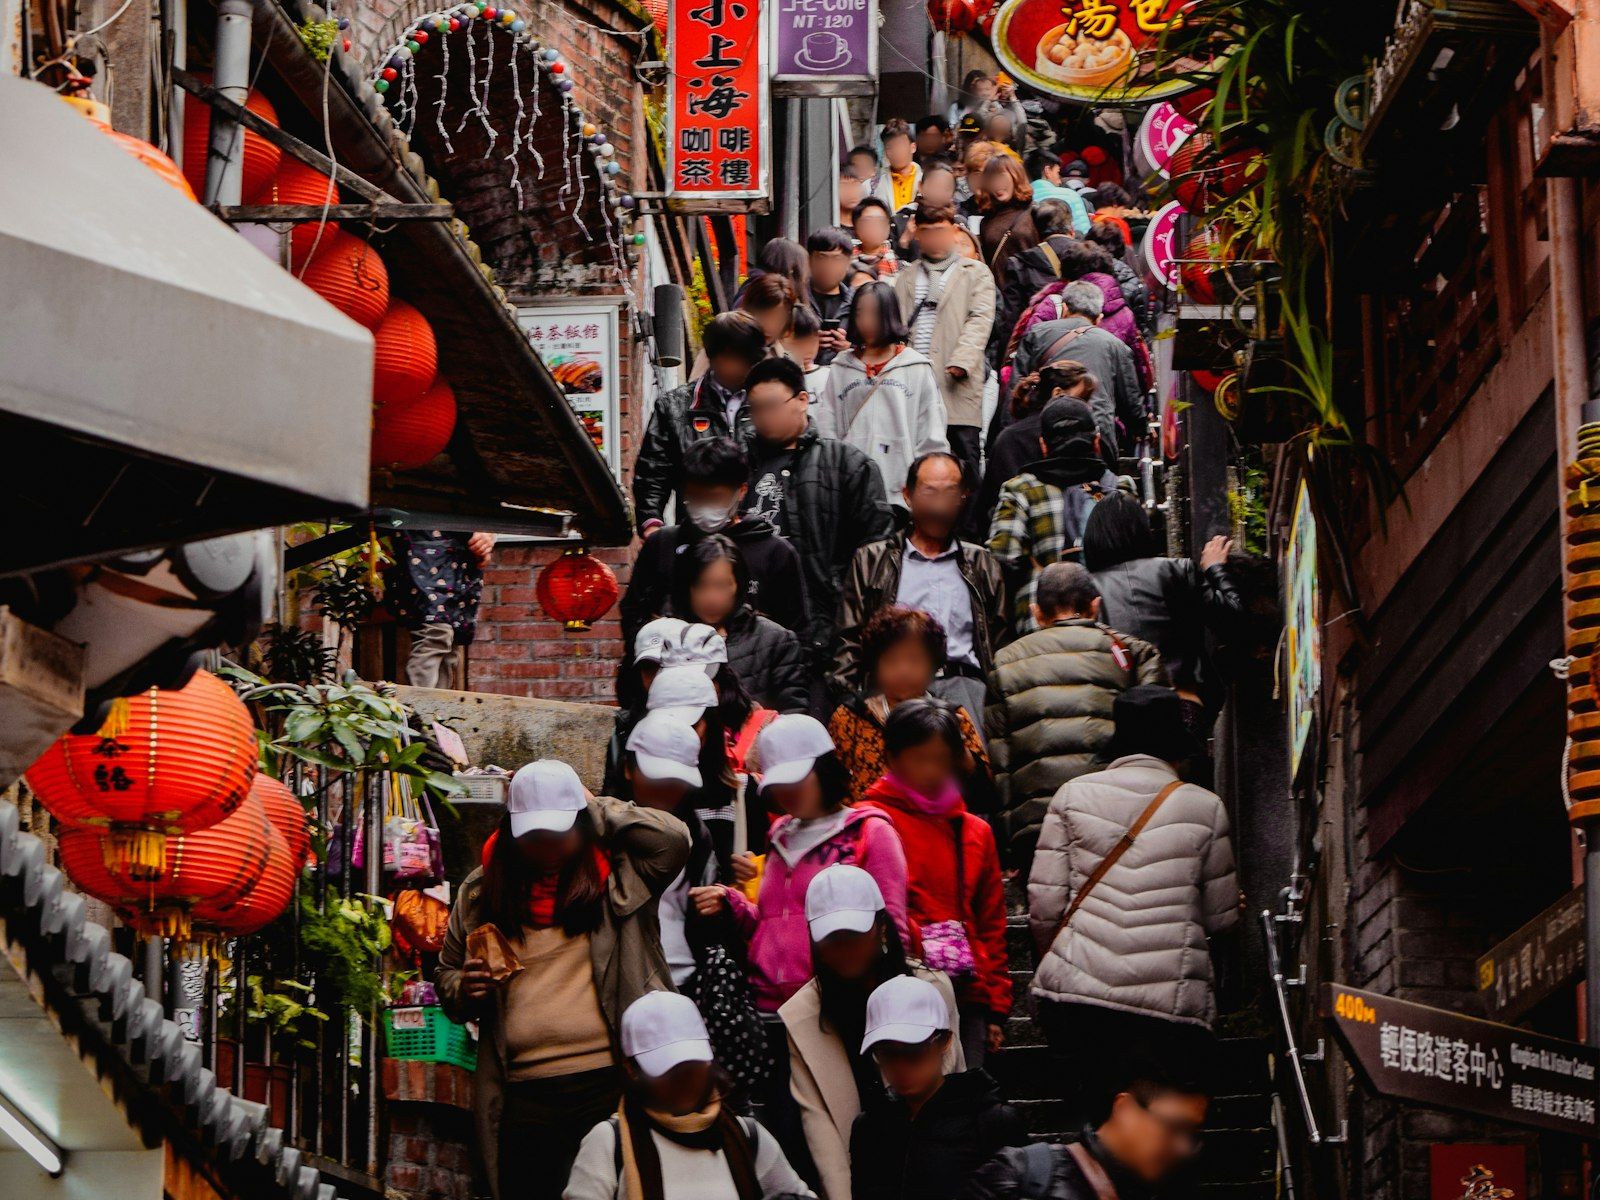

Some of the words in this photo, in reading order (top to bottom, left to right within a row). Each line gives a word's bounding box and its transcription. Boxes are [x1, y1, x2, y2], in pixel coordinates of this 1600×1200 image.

[681, 127, 751, 153] 咖啡
[681, 159, 751, 186] 茶樓
[1380, 1022, 1504, 1089] 輕便路遊客中心
